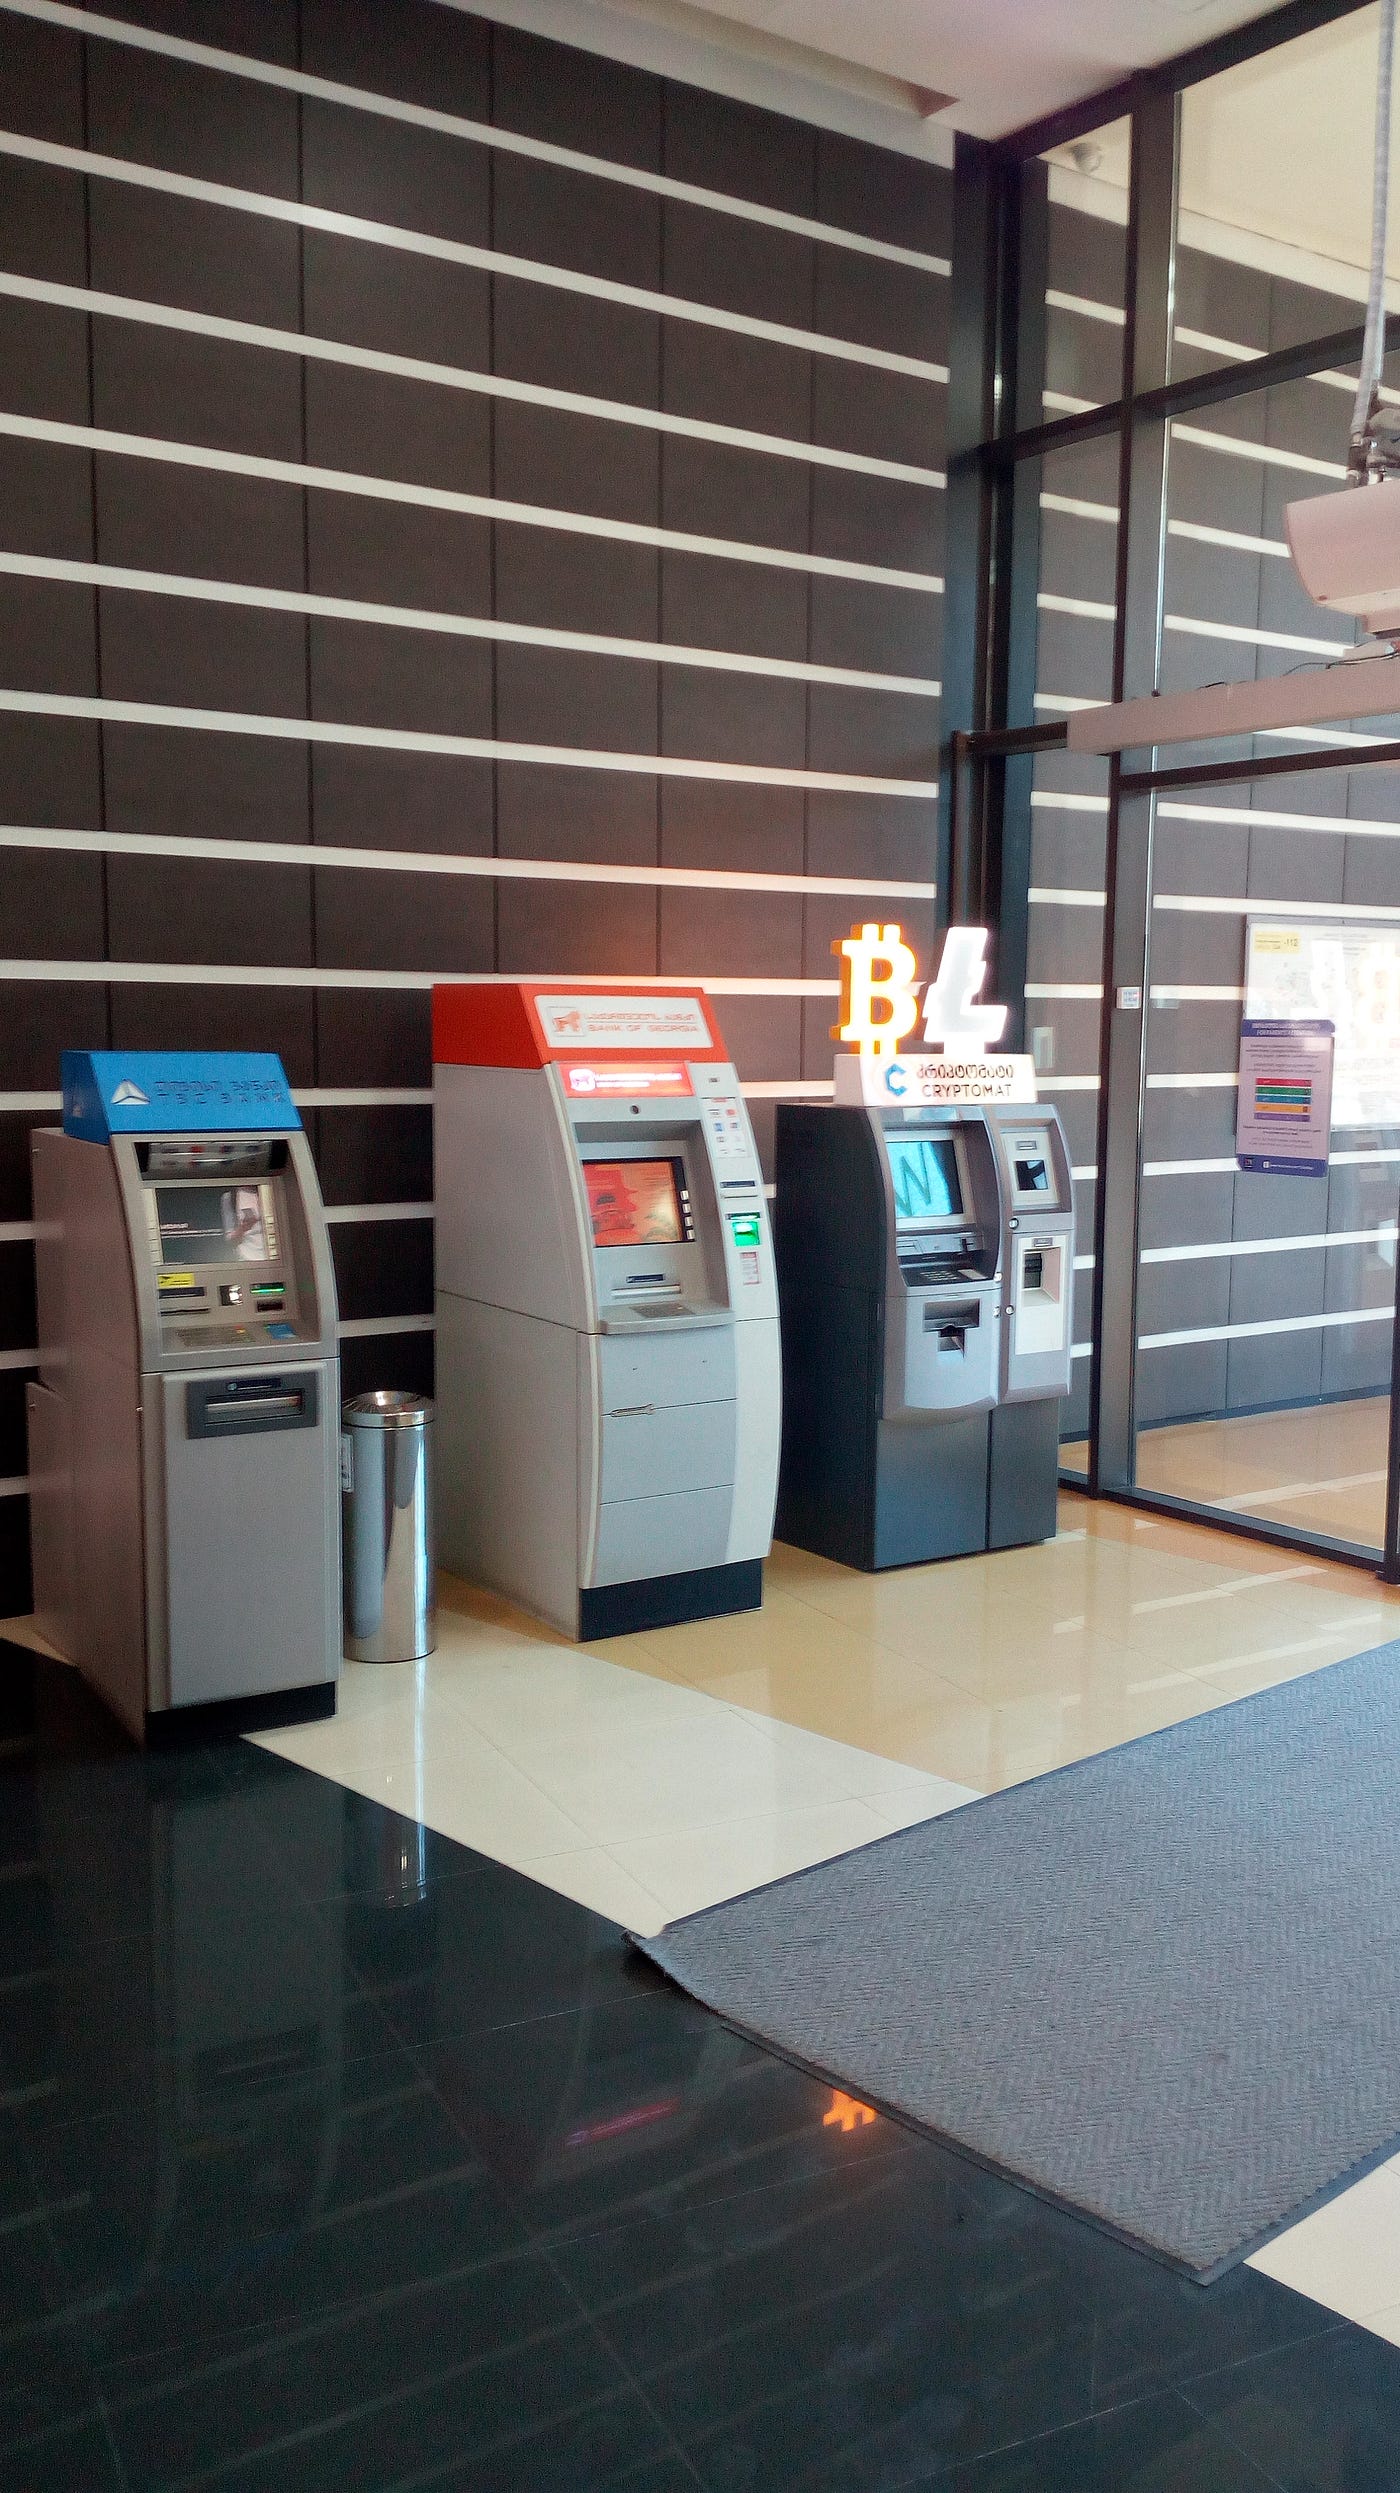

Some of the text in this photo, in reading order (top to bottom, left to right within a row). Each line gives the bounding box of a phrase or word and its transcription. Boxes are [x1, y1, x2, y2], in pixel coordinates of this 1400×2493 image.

[587, 1024, 622, 1033] BANK
[626, 1024, 642, 1032] OF
[922, 1084, 1012, 1098] CRYPTOMAT
